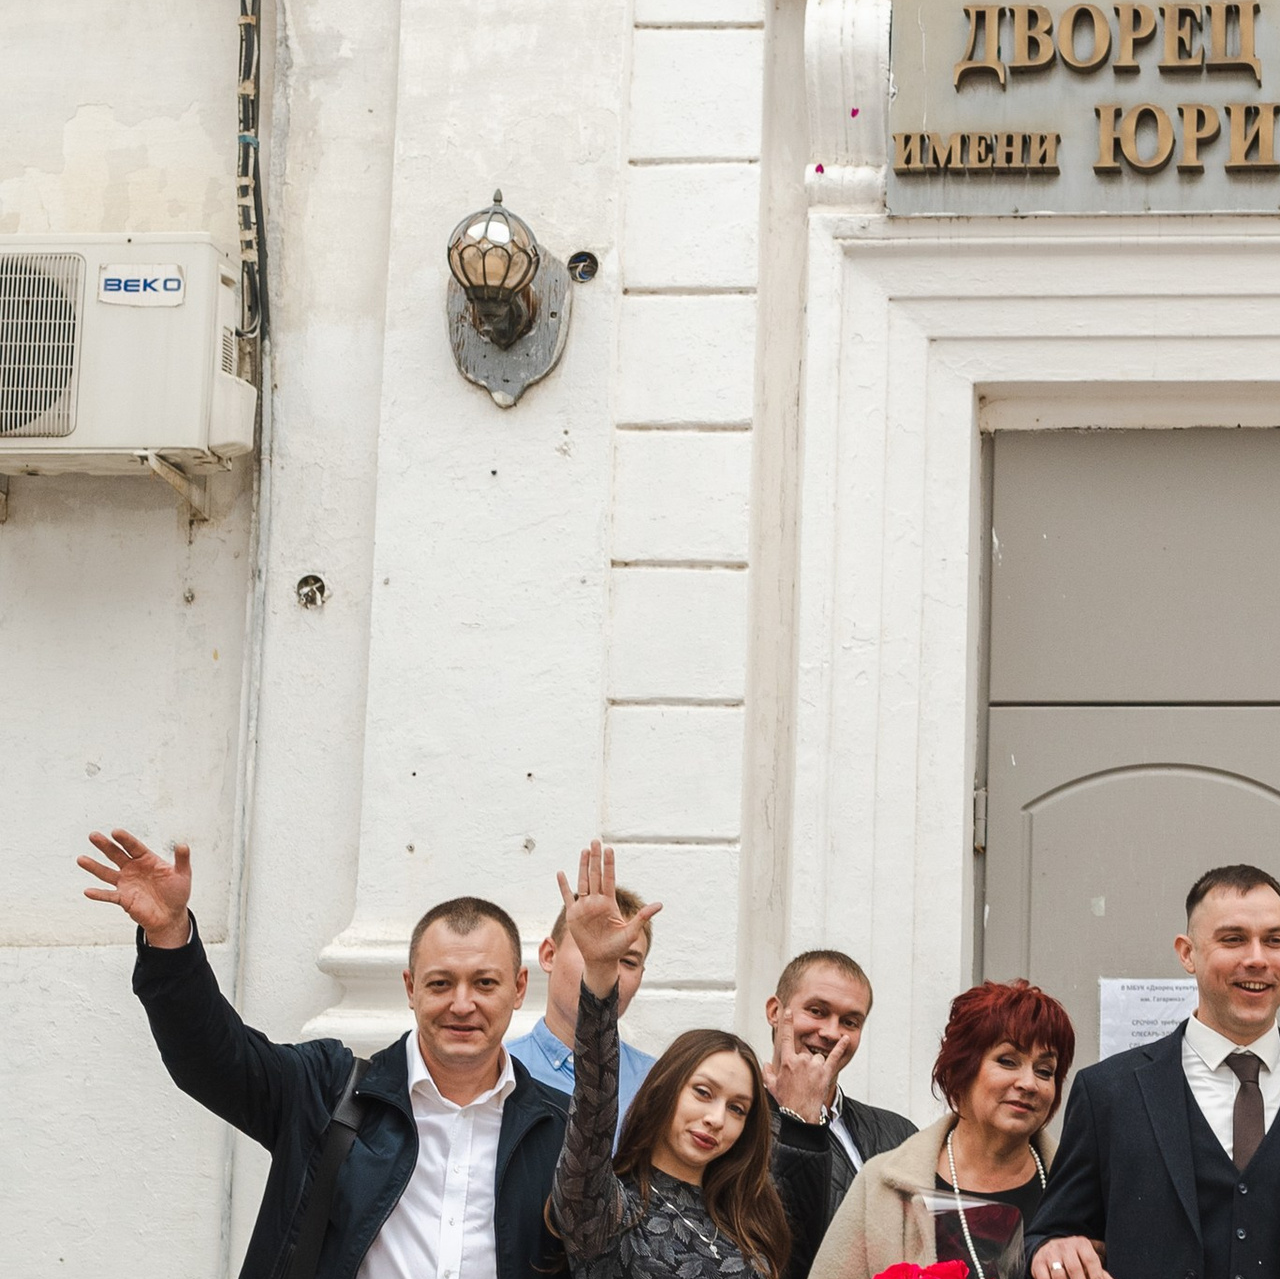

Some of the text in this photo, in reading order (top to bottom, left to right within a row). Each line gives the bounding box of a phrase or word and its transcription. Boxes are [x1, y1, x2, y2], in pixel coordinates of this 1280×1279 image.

[953, 0, 1262, 90] ДВОРЕЦ
[892, 131, 1061, 175] ИМЕНИ
[103, 278, 182, 292] BEKO
